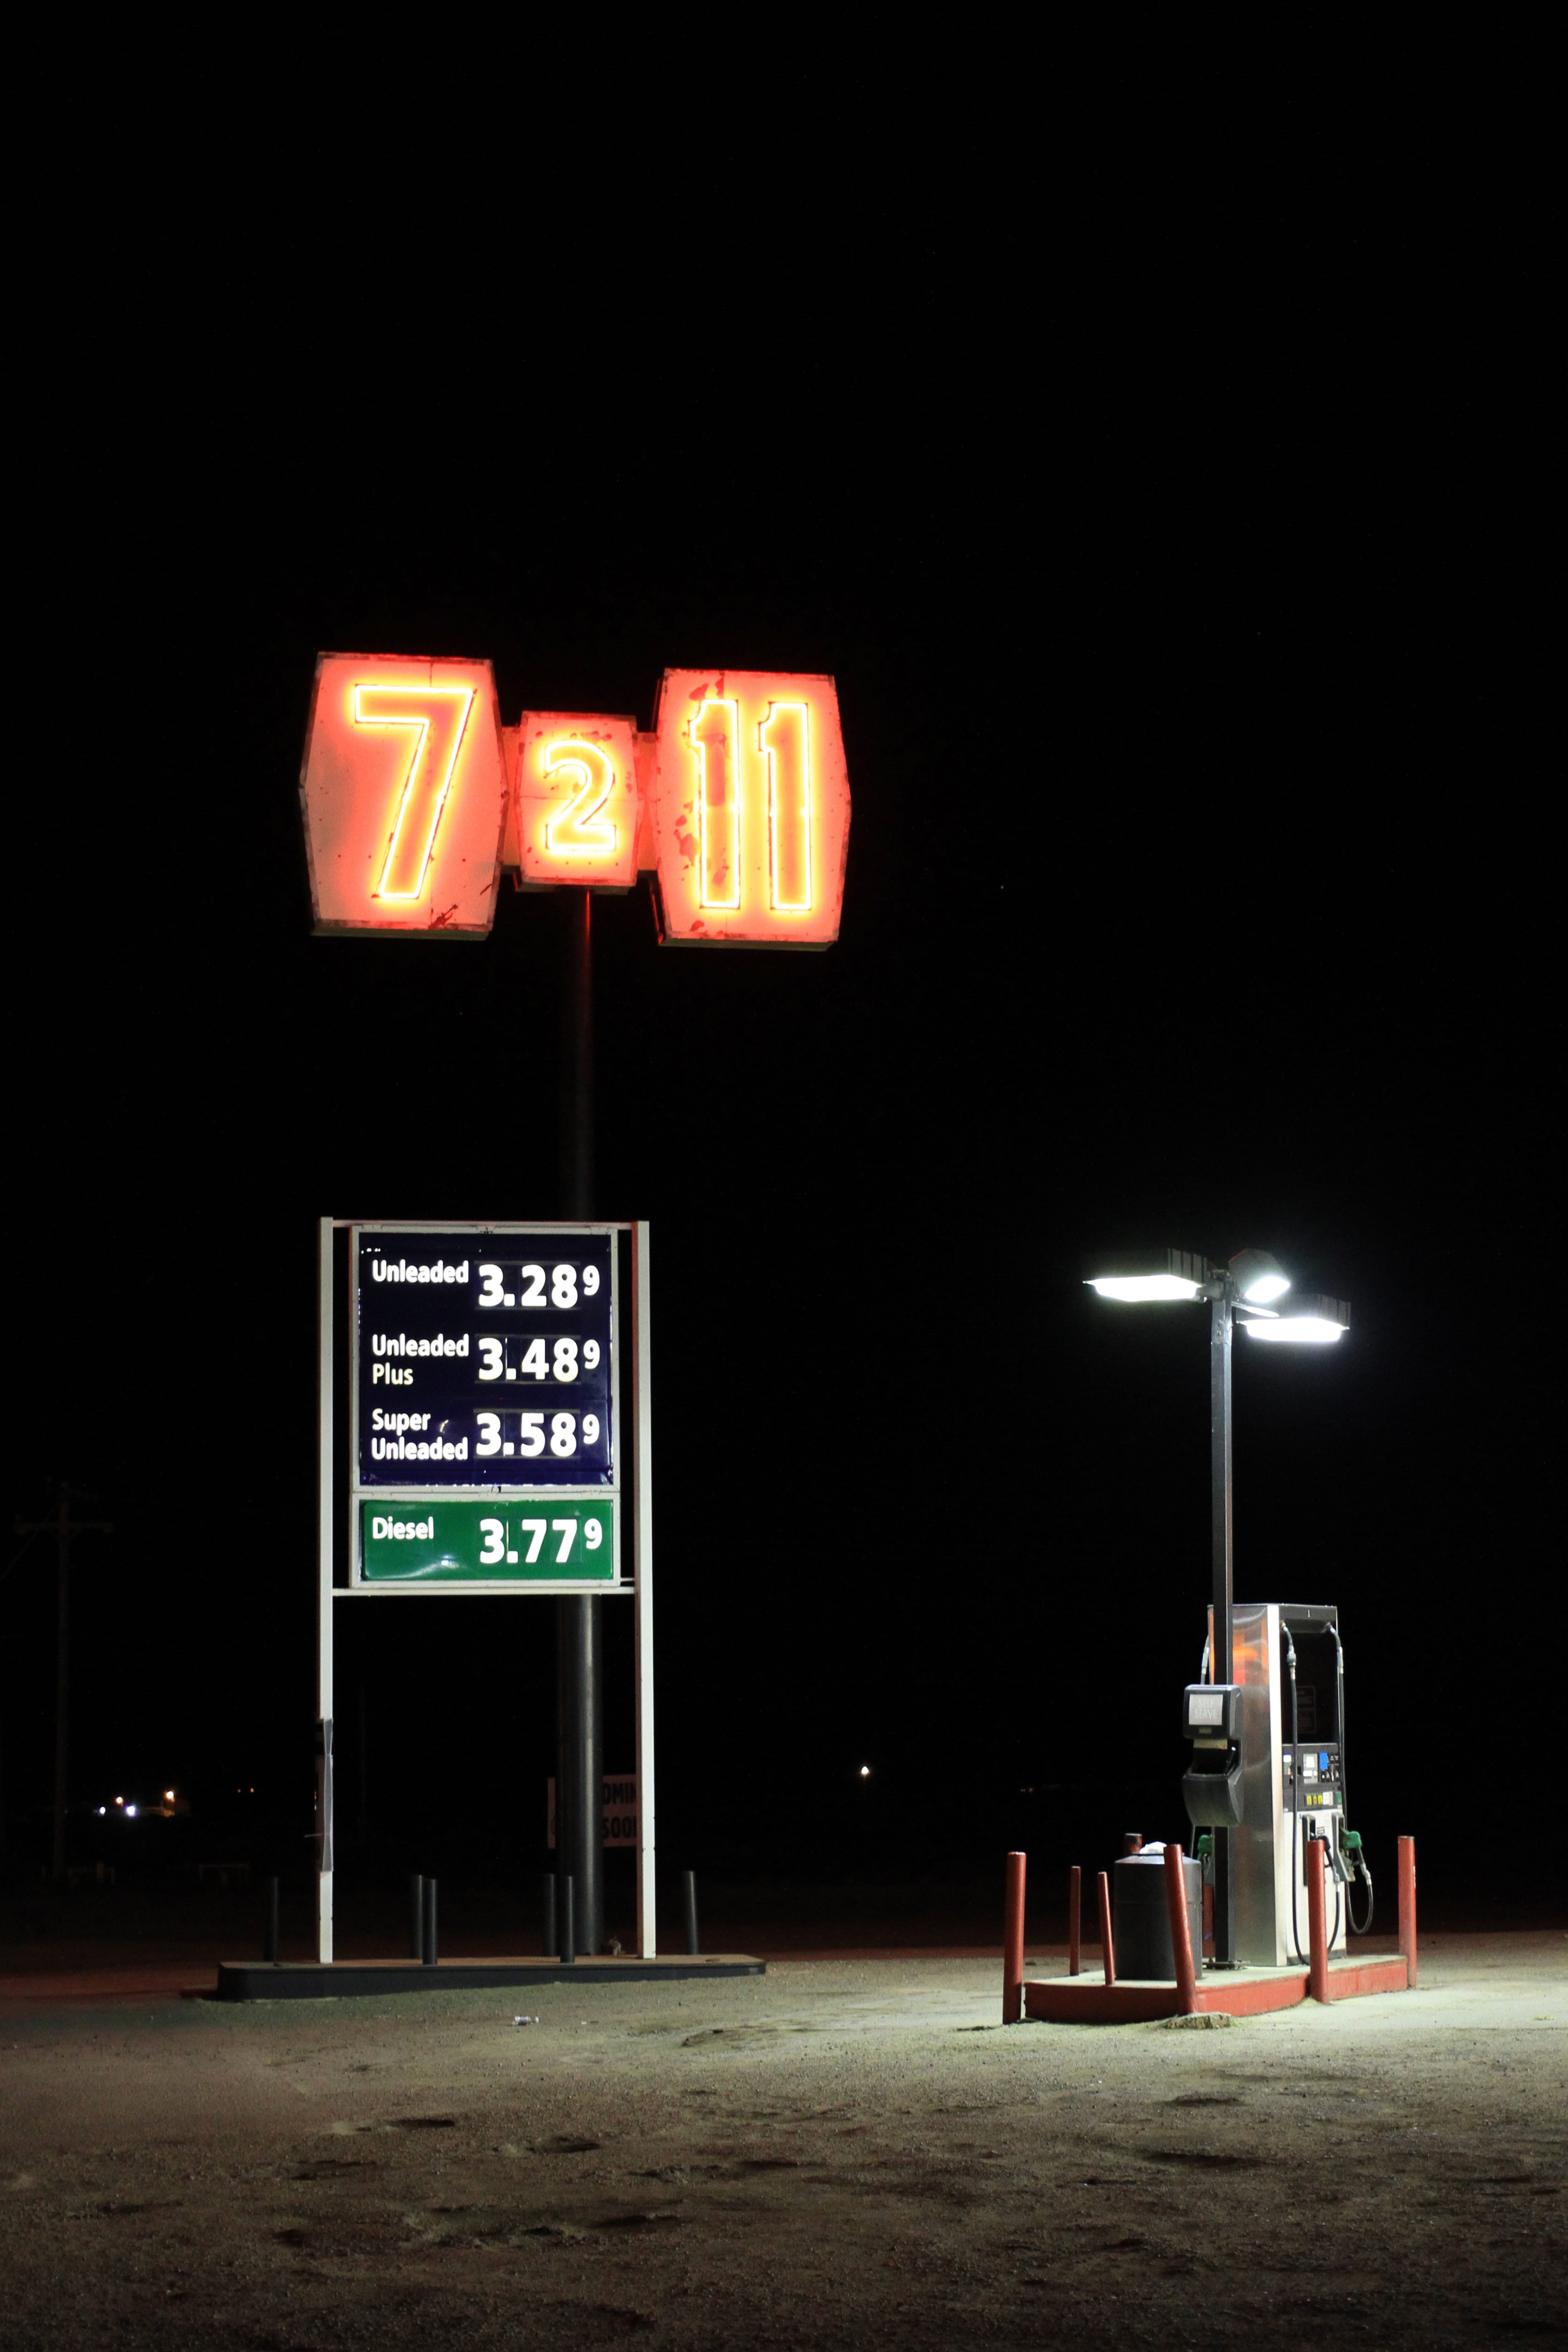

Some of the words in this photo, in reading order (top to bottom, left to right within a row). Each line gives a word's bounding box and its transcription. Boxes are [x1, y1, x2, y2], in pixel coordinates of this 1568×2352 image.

[354, 684, 476, 899] 7
[543, 739, 616, 852] 2
[688, 699, 812, 910] 11
[372, 1259, 469, 1283] Unleaded
[372, 1334, 469, 1356] Unleaded
[372, 1363, 413, 1384] Plus
[372, 1408, 430, 1436] Super
[371, 1437, 468, 1460] Unleaded
[372, 1516, 434, 1539] Diesel
[1194, 1709, 1217, 1718] SERVE
[603, 1816, 636, 1839] SOO
